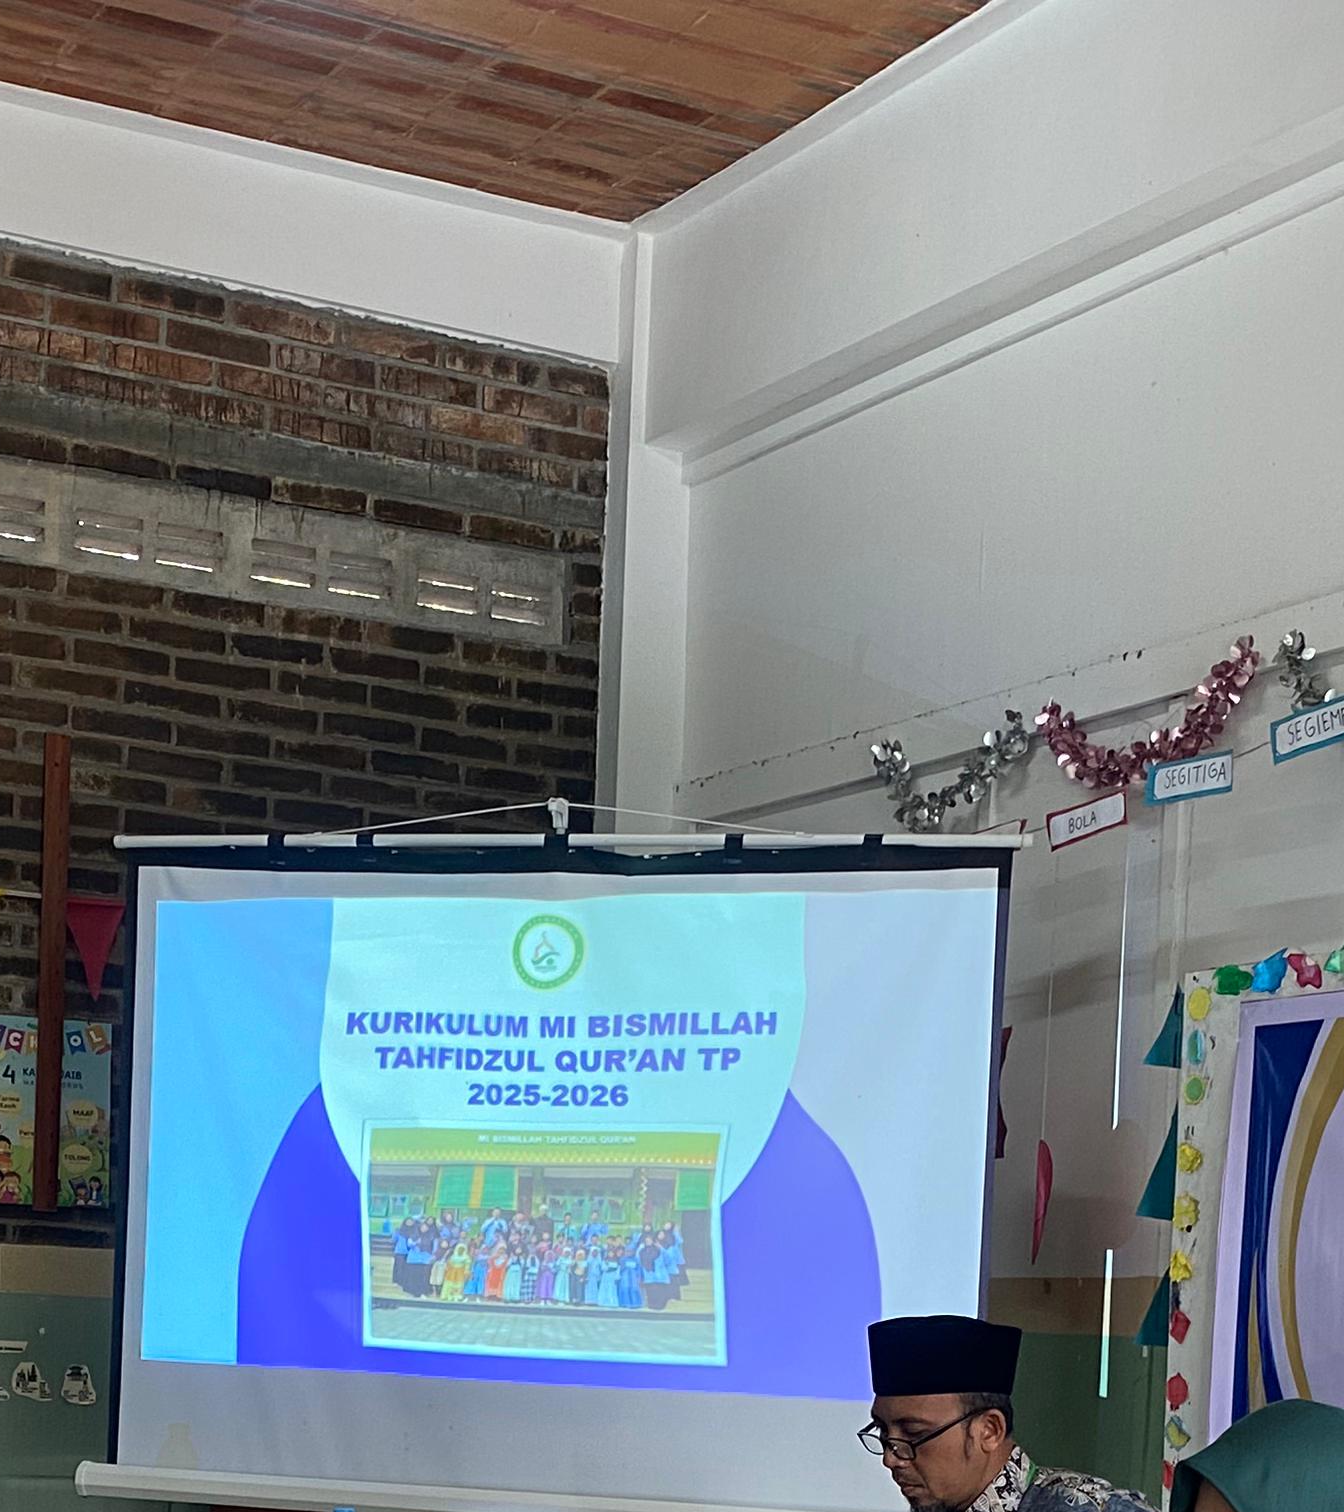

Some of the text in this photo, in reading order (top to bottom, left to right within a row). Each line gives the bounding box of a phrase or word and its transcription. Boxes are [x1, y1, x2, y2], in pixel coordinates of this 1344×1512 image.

[1163, 761, 1228, 790] SEGITIGA
[1067, 811, 1099, 834] BOLA
[345, 1010, 778, 1039] KURIKULUM MI BISMILLAH
[374, 1045, 545, 1073] TAHFIDZUL
[696, 1047, 742, 1072] TP
[2, 1064, 16, 1085] 4
[467, 1082, 629, 1107] 2025-2026
